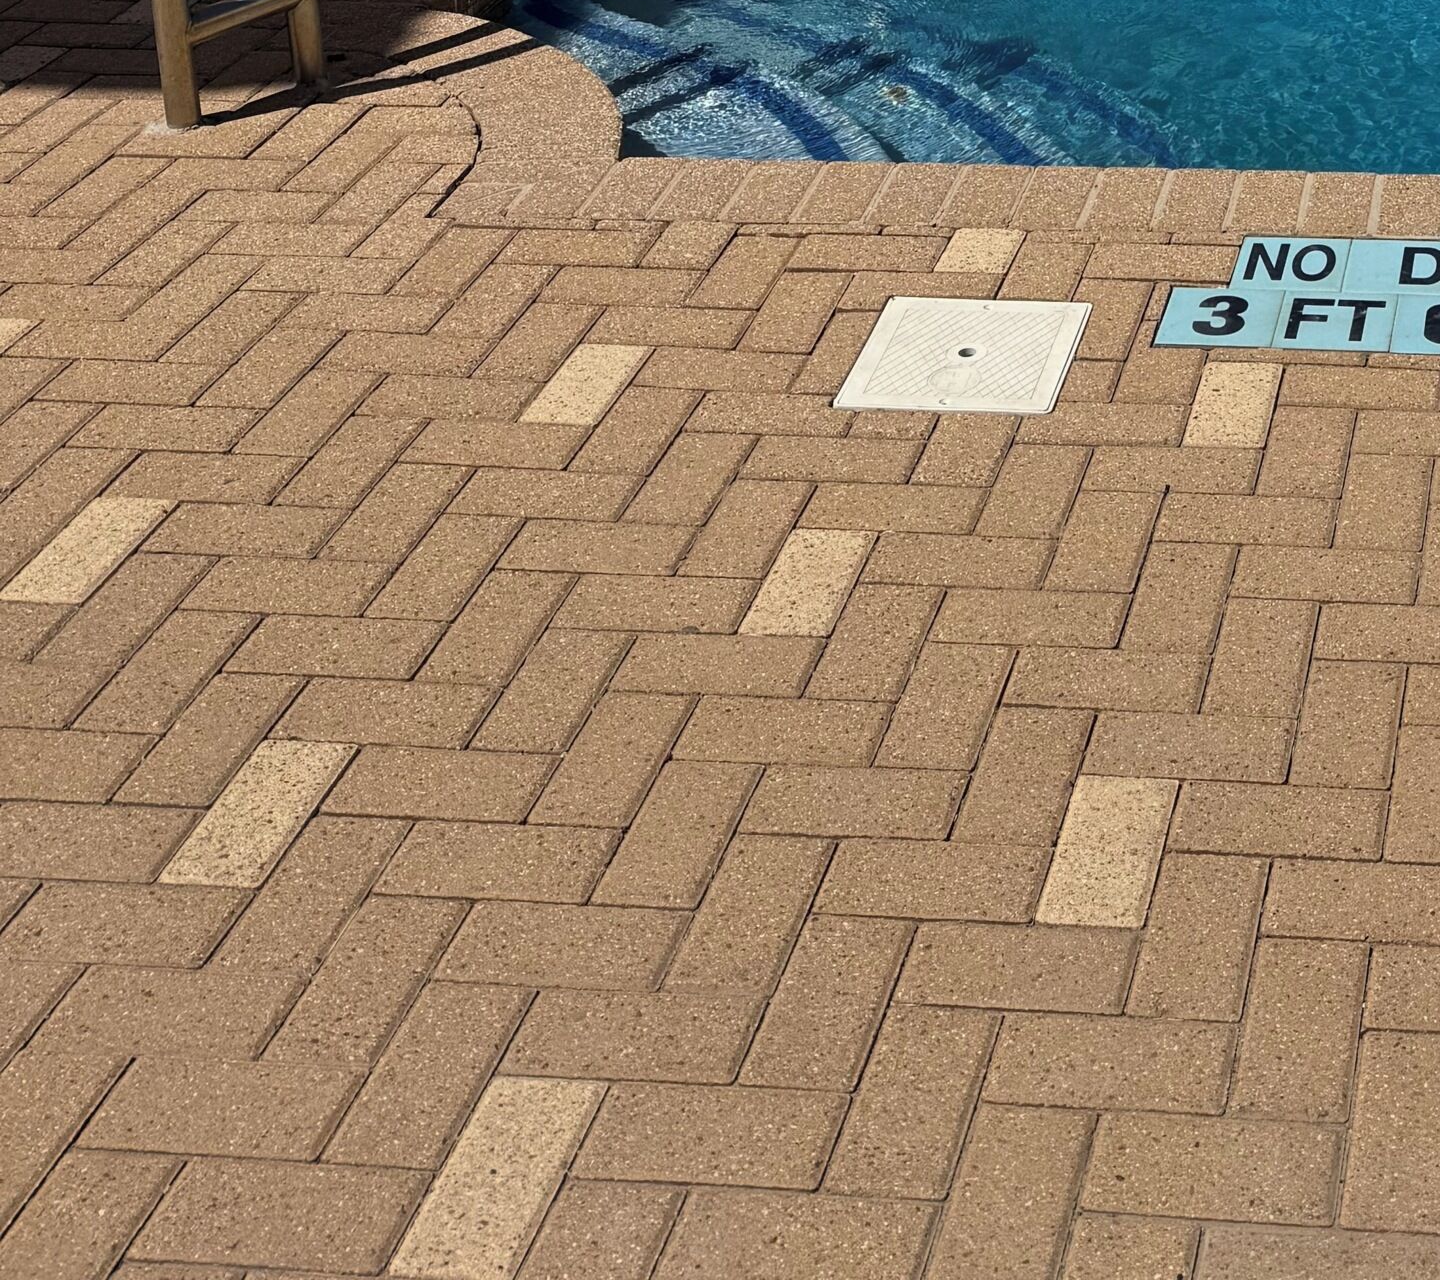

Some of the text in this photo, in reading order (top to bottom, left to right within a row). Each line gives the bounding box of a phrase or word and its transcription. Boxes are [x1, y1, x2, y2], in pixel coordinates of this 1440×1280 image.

[1242, 242, 1336, 282] NO
[1191, 294, 1249, 336] 3
[1283, 297, 1386, 343] FT
